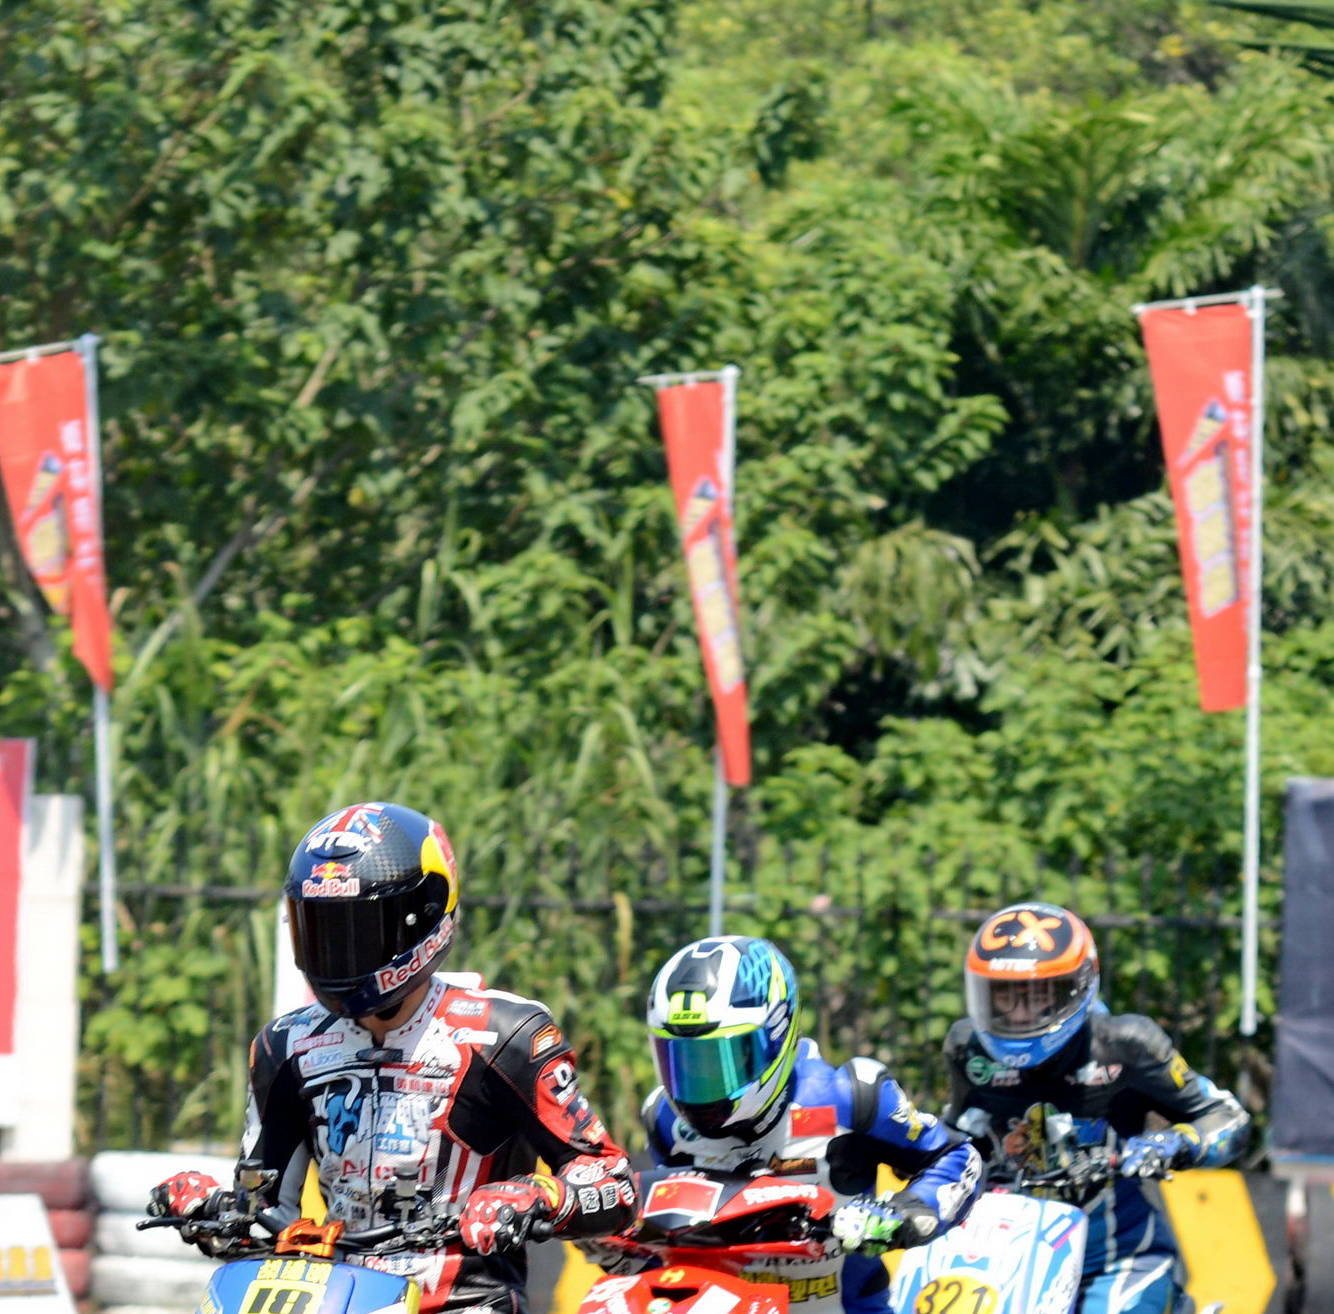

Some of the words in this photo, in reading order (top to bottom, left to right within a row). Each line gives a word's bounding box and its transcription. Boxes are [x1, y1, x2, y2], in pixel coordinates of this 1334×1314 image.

[302, 879, 328, 898] Red
[328, 878, 360, 897] Bull
[379, 947, 422, 992] Red
